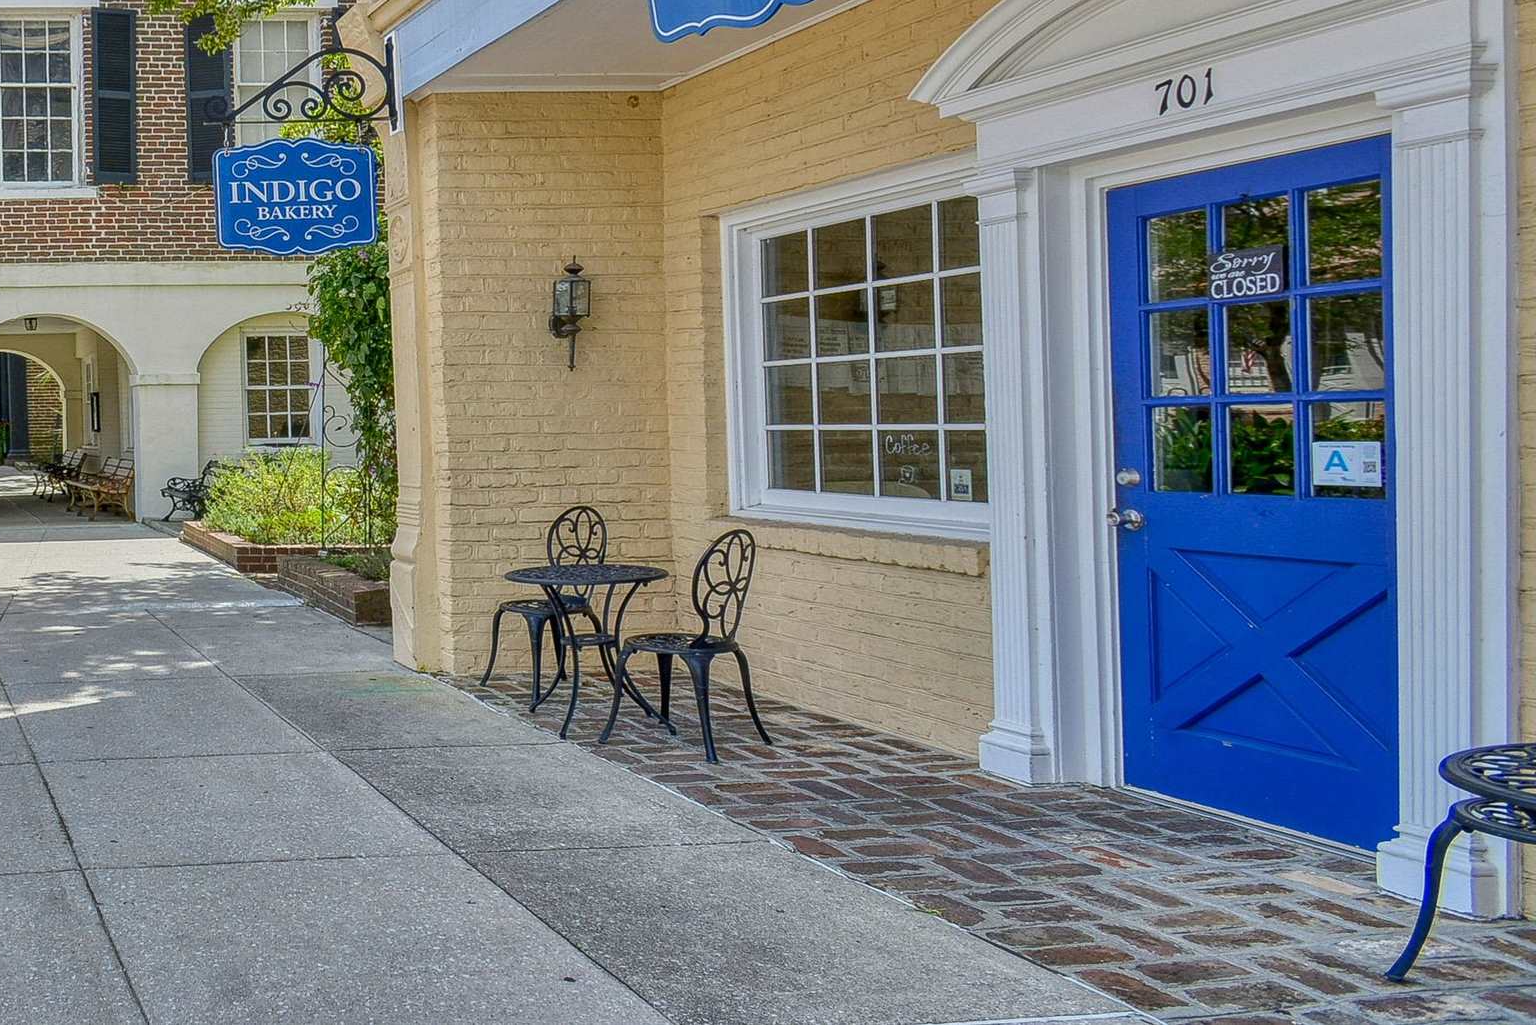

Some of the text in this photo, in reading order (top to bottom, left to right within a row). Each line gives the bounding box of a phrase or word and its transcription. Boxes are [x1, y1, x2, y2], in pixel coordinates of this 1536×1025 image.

[1154, 67, 1214, 116] 701
[228, 178, 362, 204] INDIGO
[256, 205, 338, 221] BAKERY
[1210, 252, 1277, 275] Sorry
[1211, 273, 1280, 299] CLOSED
[885, 433, 932, 456] Coffee
[1323, 449, 1349, 472] A
